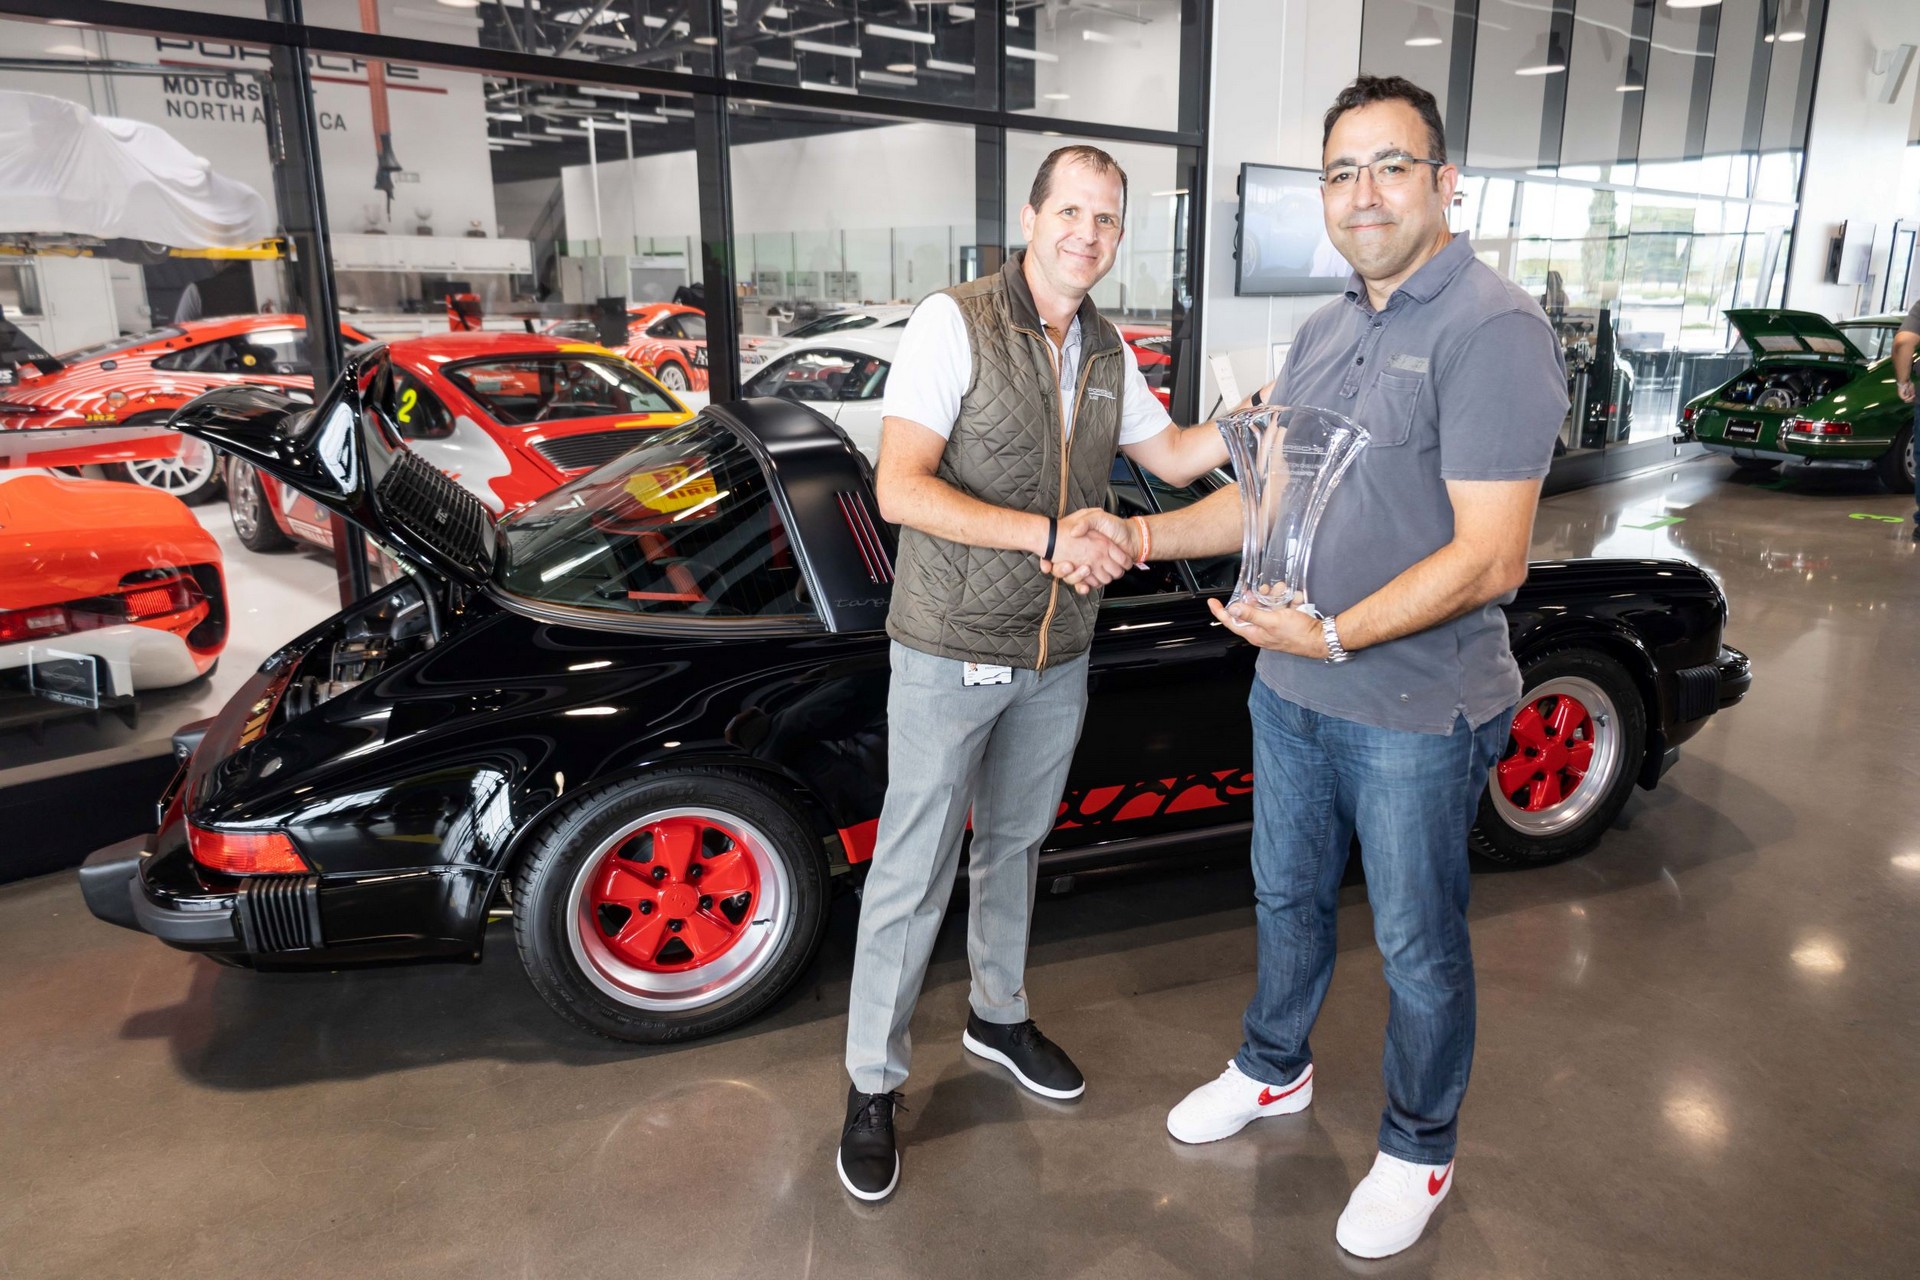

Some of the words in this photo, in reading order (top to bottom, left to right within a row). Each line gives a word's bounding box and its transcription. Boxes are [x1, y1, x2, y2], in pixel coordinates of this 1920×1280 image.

[166, 99, 245, 122] NORTH
[397, 388, 417, 423] 2
[834, 597, 889, 608] targ
[1054, 768, 1254, 828] arre
